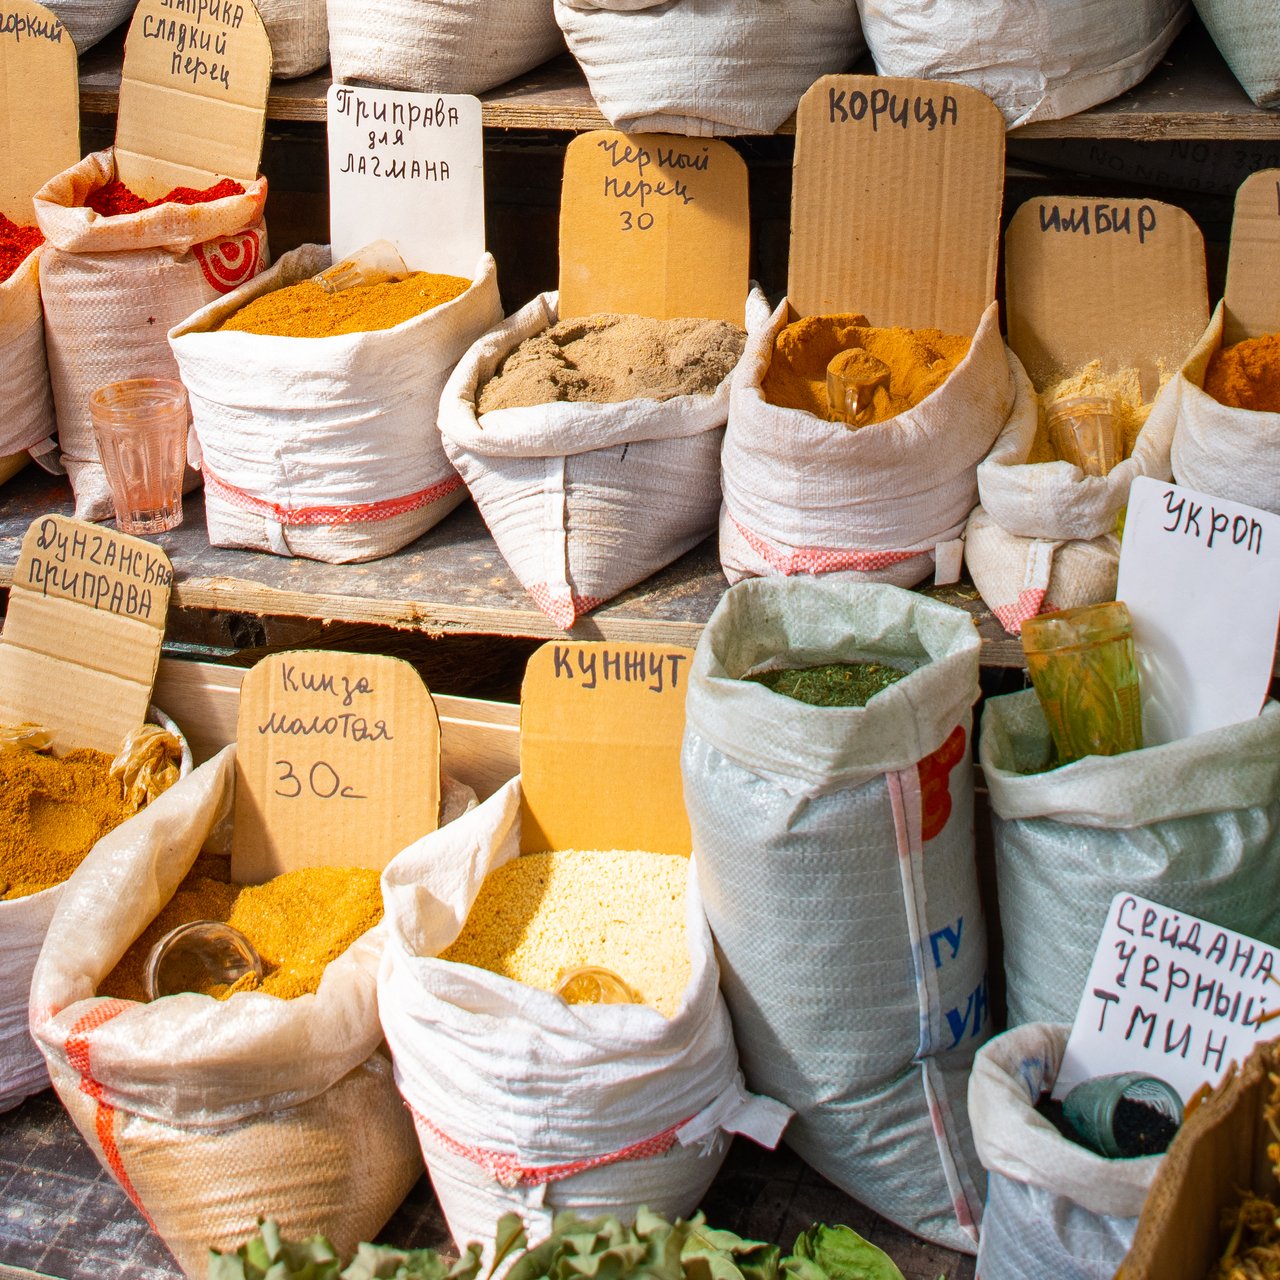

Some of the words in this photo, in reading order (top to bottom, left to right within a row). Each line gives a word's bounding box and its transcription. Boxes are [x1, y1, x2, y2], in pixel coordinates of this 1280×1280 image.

[141, 14, 228, 57] СЛАДКИЙ
[828, 87, 959, 132] КОРИЦА
[367, 129, 406, 150] для
[596, 138, 710, 176] Черный
[340, 152, 452, 182] ЛАГМАНА
[619, 210, 655, 232] 30
[1039, 203, 1158, 244] ИМБИР
[1161, 489, 1264, 556] УКРОП
[28, 556, 154, 620] ПРИПРАВА
[280, 661, 376, 713] Кинза
[552, 644, 688, 693] КУНЖУТ
[258, 709, 395, 742] молотая
[1116, 897, 1275, 985] СЕЙДАНА
[1113, 940, 1269, 1031] ЧЕРНЫЙ
[1092, 987, 1229, 1075] ТМИН
